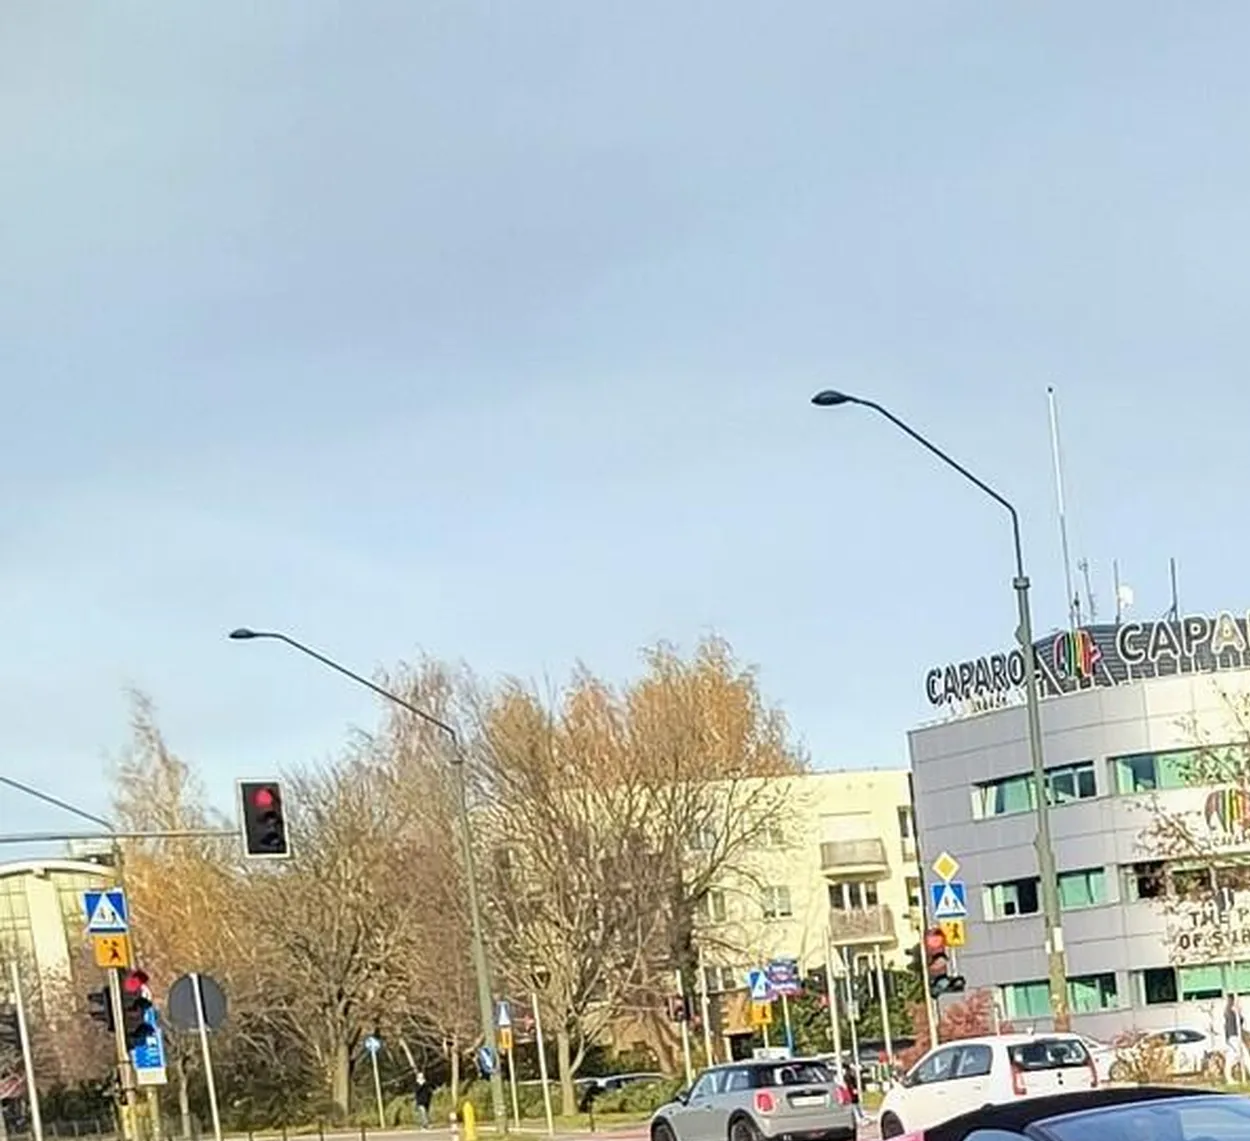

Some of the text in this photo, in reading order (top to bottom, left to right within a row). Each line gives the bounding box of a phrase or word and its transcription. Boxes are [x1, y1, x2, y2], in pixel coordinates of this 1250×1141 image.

[926, 648, 1042, 706] CAPARO
[1189, 910, 1230, 927] THE
[1180, 932, 1203, 949] OF
